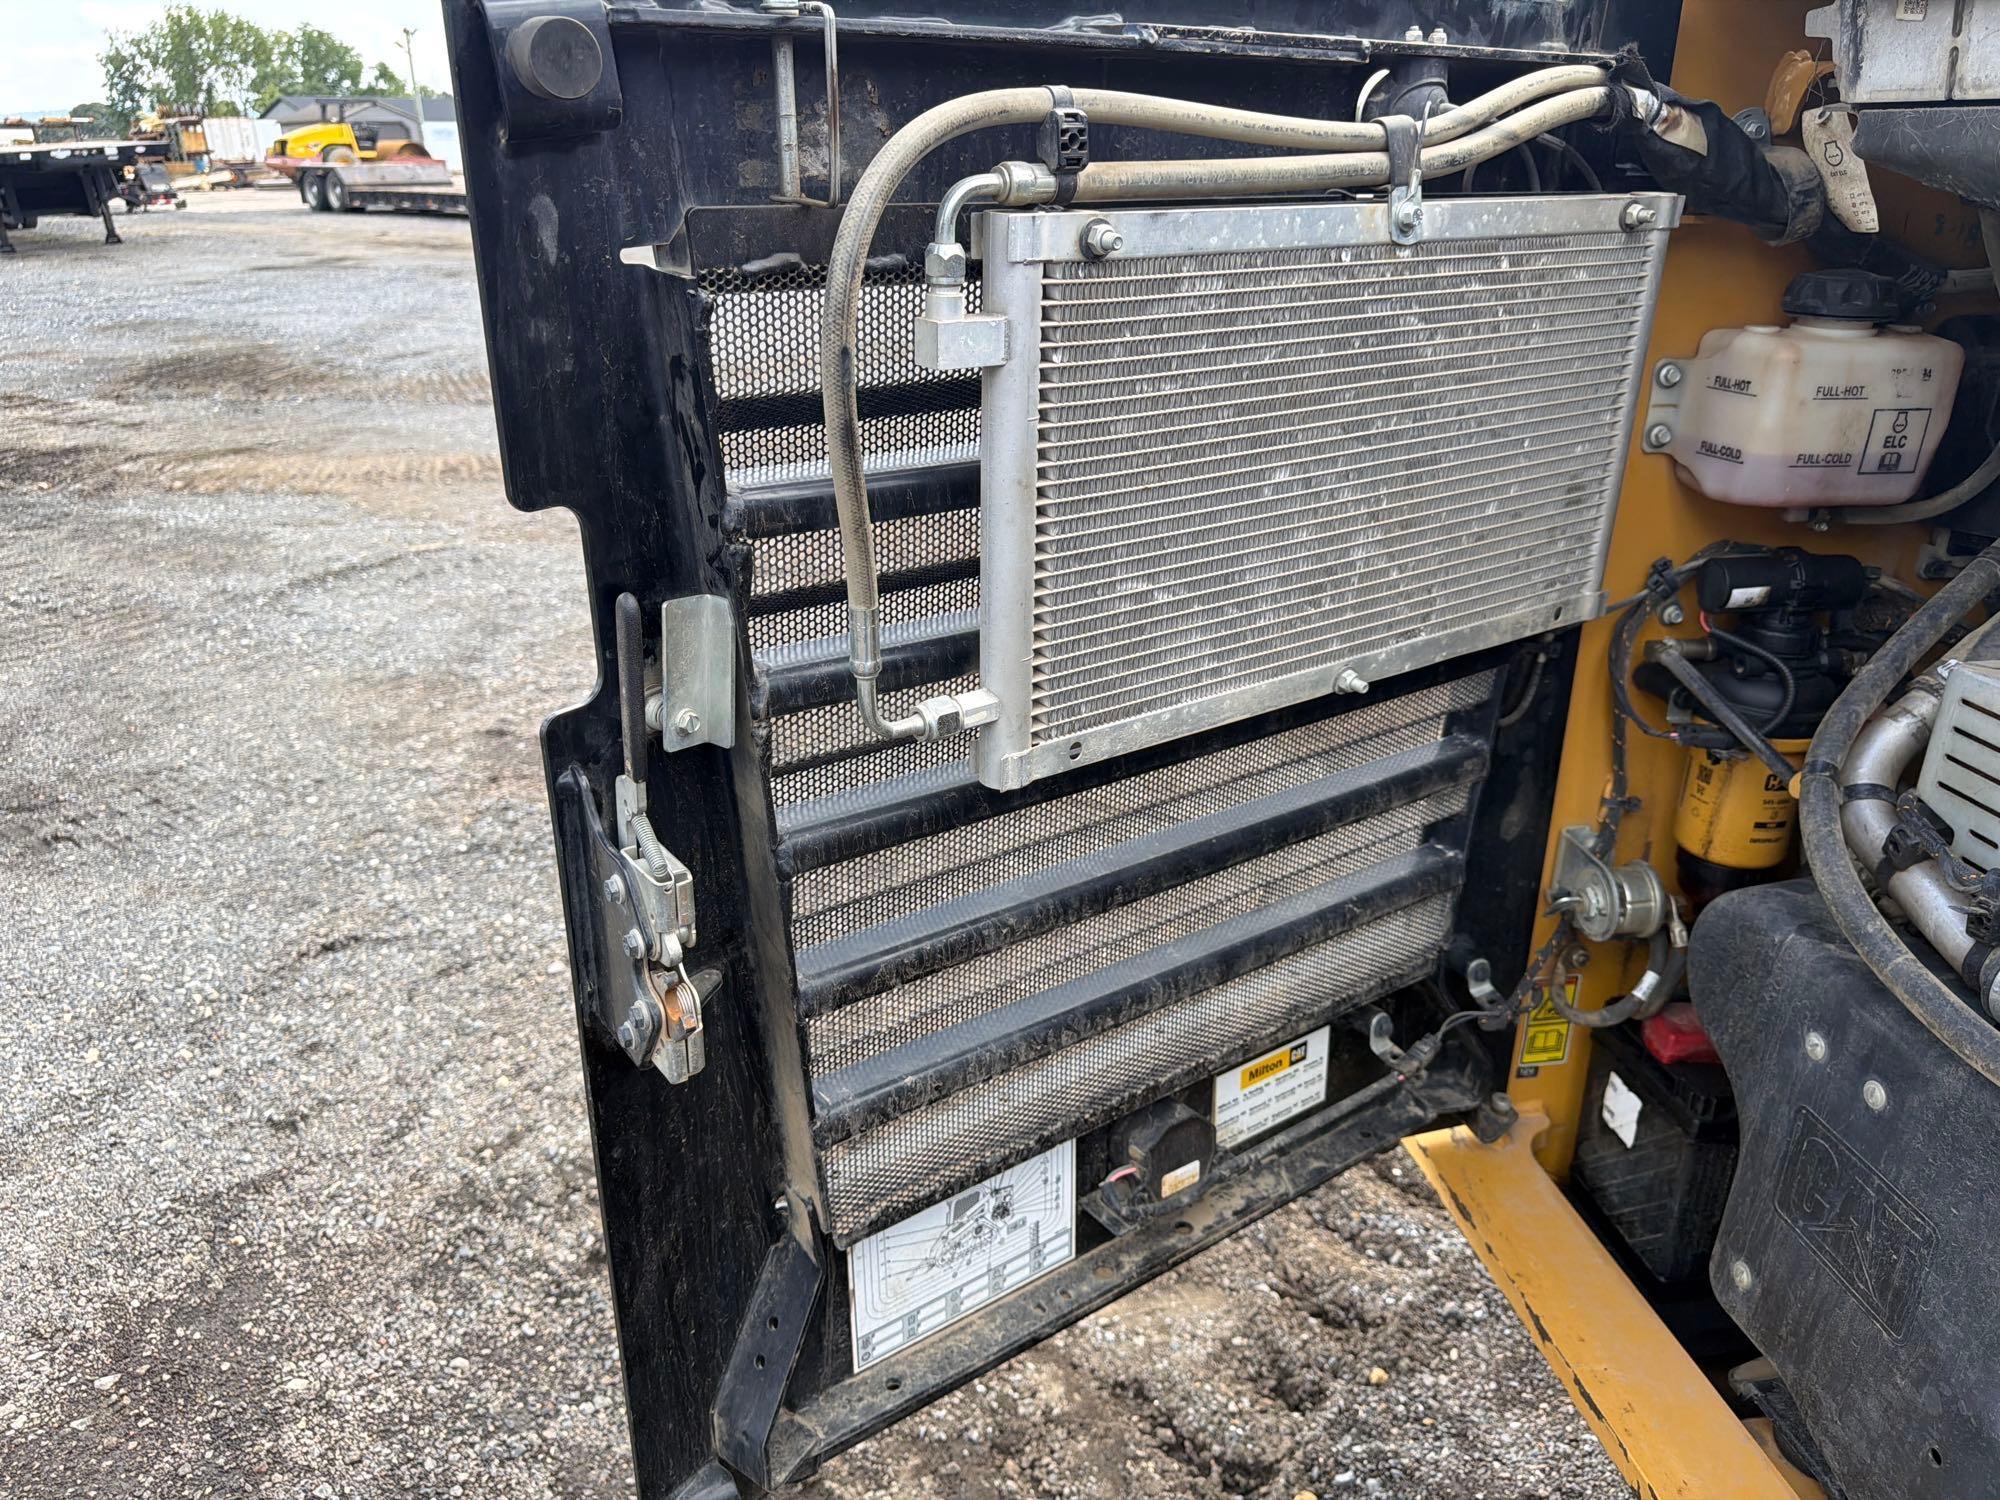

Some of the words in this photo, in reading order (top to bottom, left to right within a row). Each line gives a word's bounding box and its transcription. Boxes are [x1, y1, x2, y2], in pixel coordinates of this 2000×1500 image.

[1713, 375, 1752, 392] FULL-HOT
[1816, 385, 1866, 397] FULL-HOT
[1883, 435, 1908, 449] ELC
[1700, 441, 1742, 459] FULL-COLD
[1796, 453, 1852, 465] FULL-COLD
[1249, 1060, 1283, 1081] Milton
